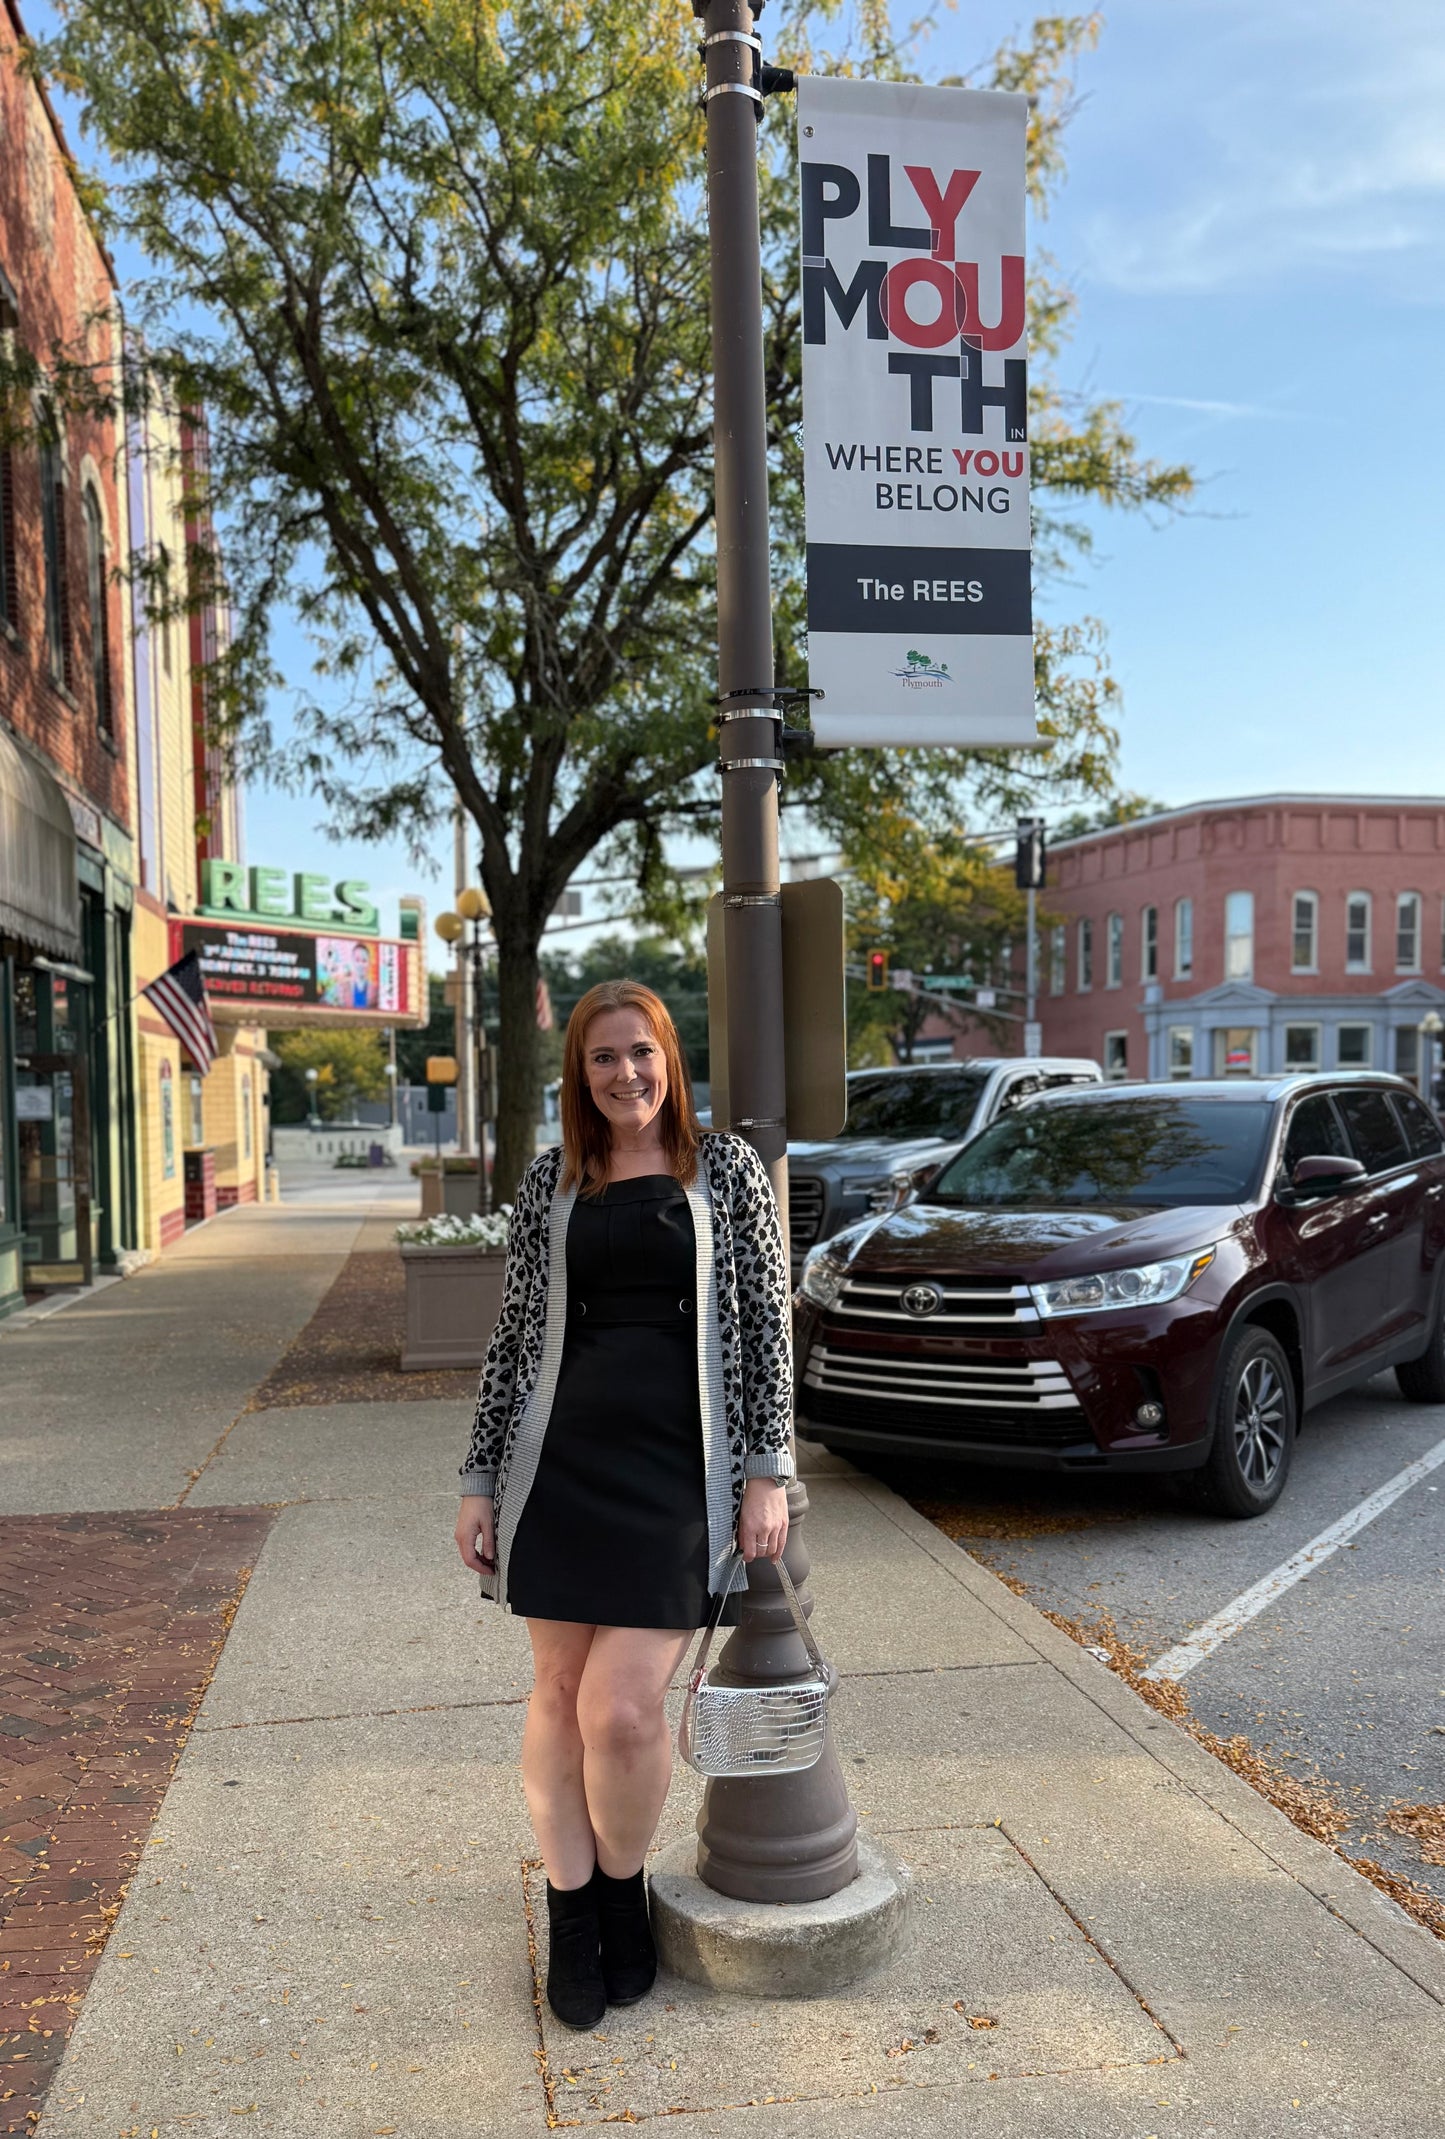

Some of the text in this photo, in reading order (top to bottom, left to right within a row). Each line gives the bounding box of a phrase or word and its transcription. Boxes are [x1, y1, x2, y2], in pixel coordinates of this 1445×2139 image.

[1010, 427, 1025, 440] IN
[825, 443, 1024, 478] WHERE YOU
[875, 482, 1011, 514] BELONG
[857, 578, 984, 603] The REES
[902, 677, 944, 689] Plymouth
[202, 859, 377, 926] REES
